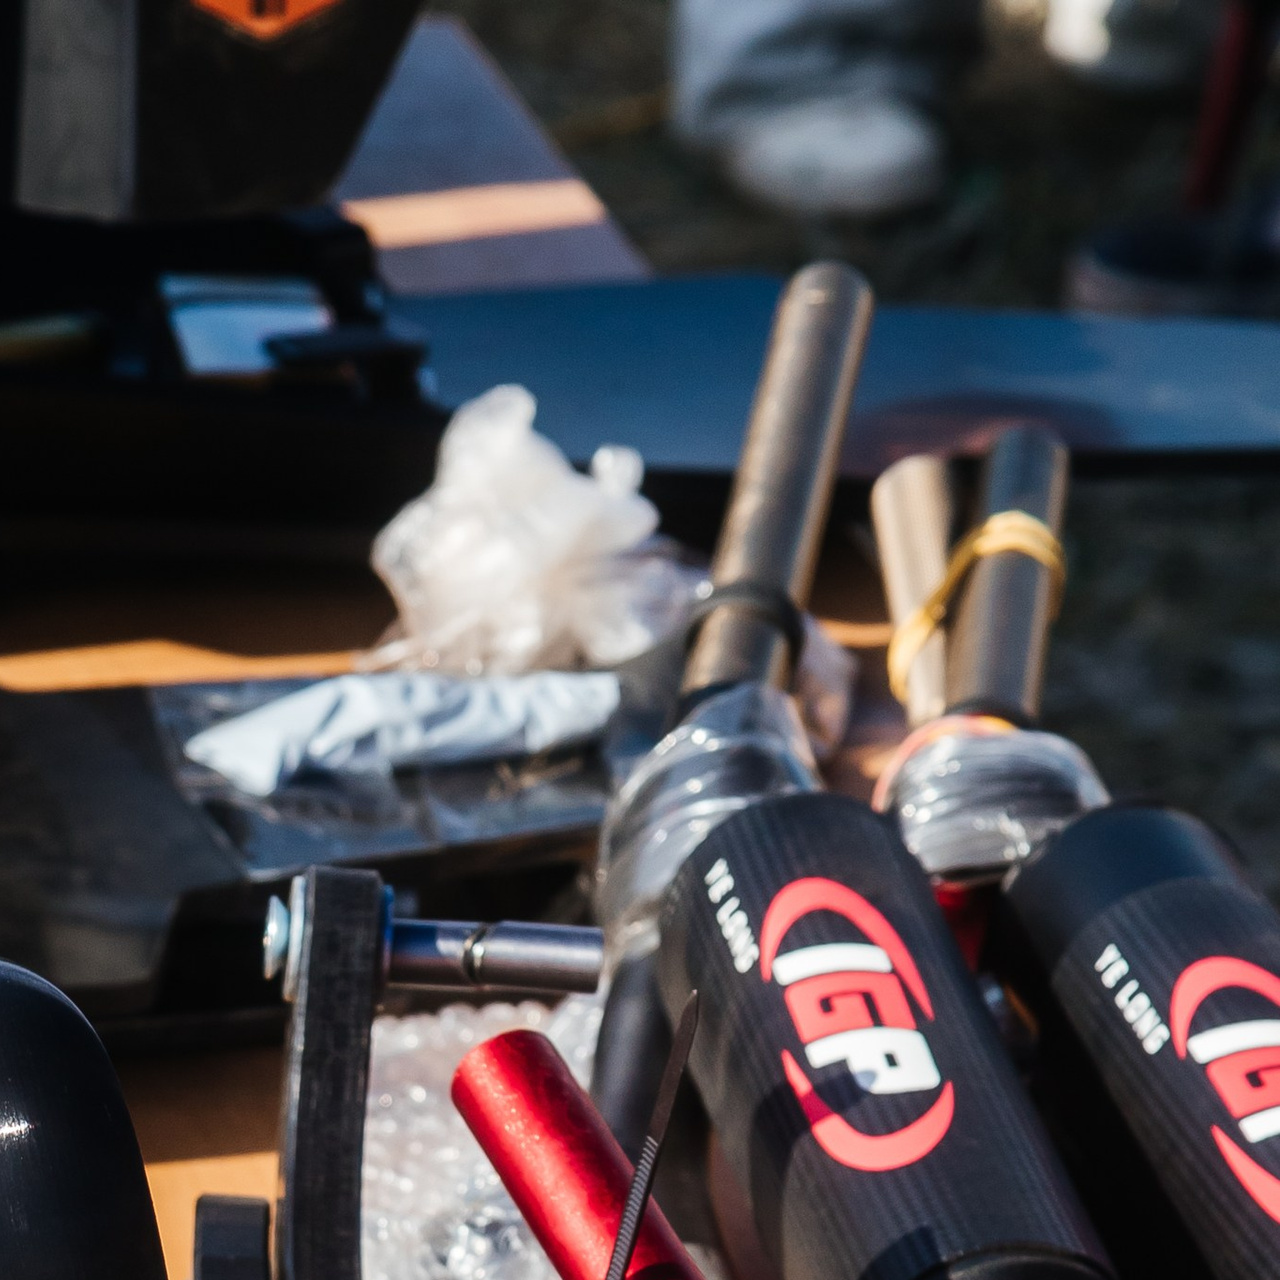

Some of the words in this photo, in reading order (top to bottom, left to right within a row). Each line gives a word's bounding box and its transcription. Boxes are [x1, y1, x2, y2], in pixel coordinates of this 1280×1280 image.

[716, 896, 759, 973] LONG
[773, 943, 941, 1094] IGP
[1115, 979, 1170, 1055] LONG
[1187, 1019, 1280, 1143] IG
